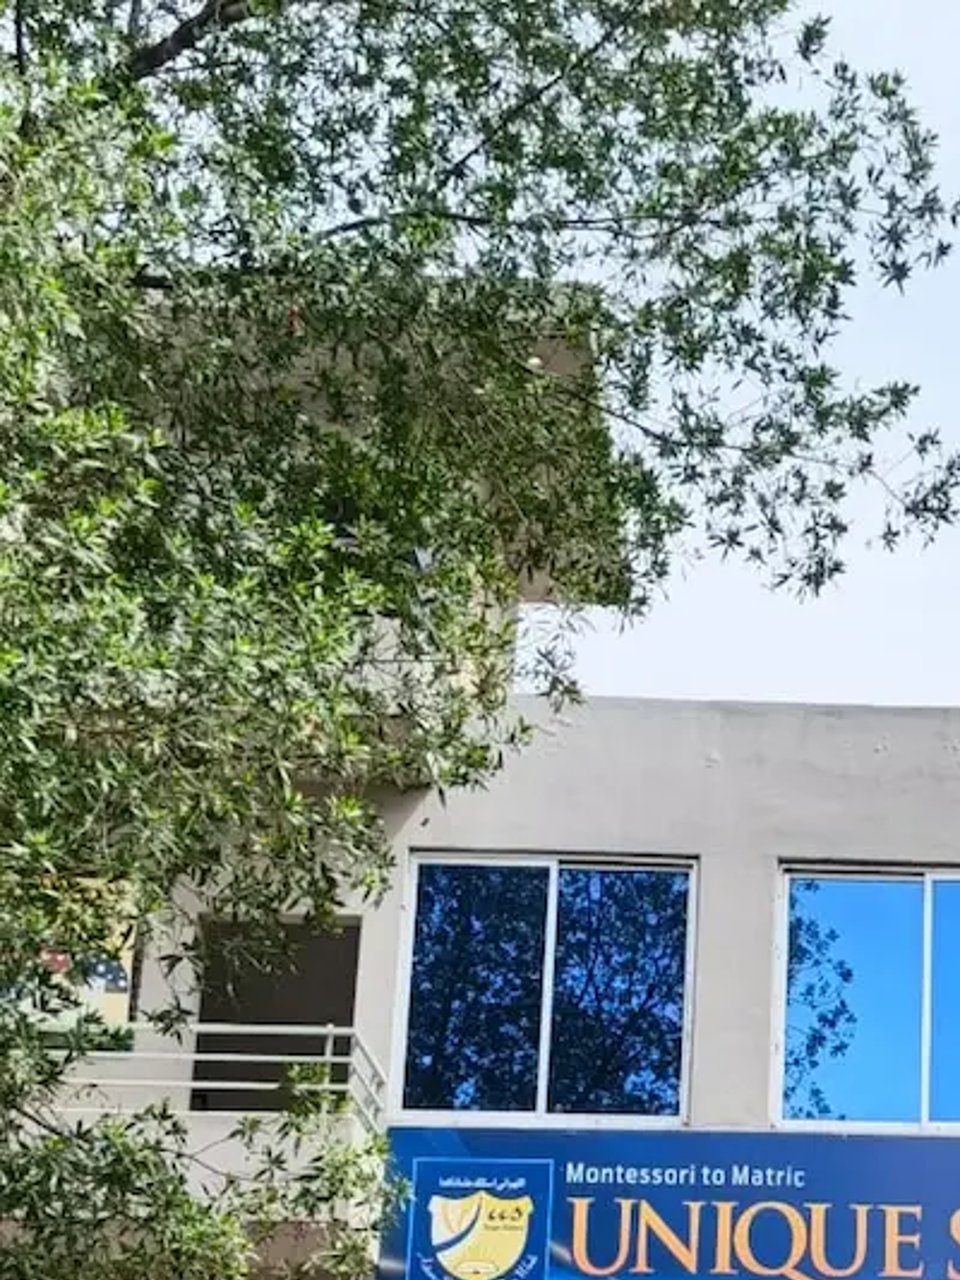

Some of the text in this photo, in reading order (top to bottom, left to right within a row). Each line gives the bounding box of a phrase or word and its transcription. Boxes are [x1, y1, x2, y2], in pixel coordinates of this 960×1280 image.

[565, 1161, 806, 1188] Montessori to Matric
